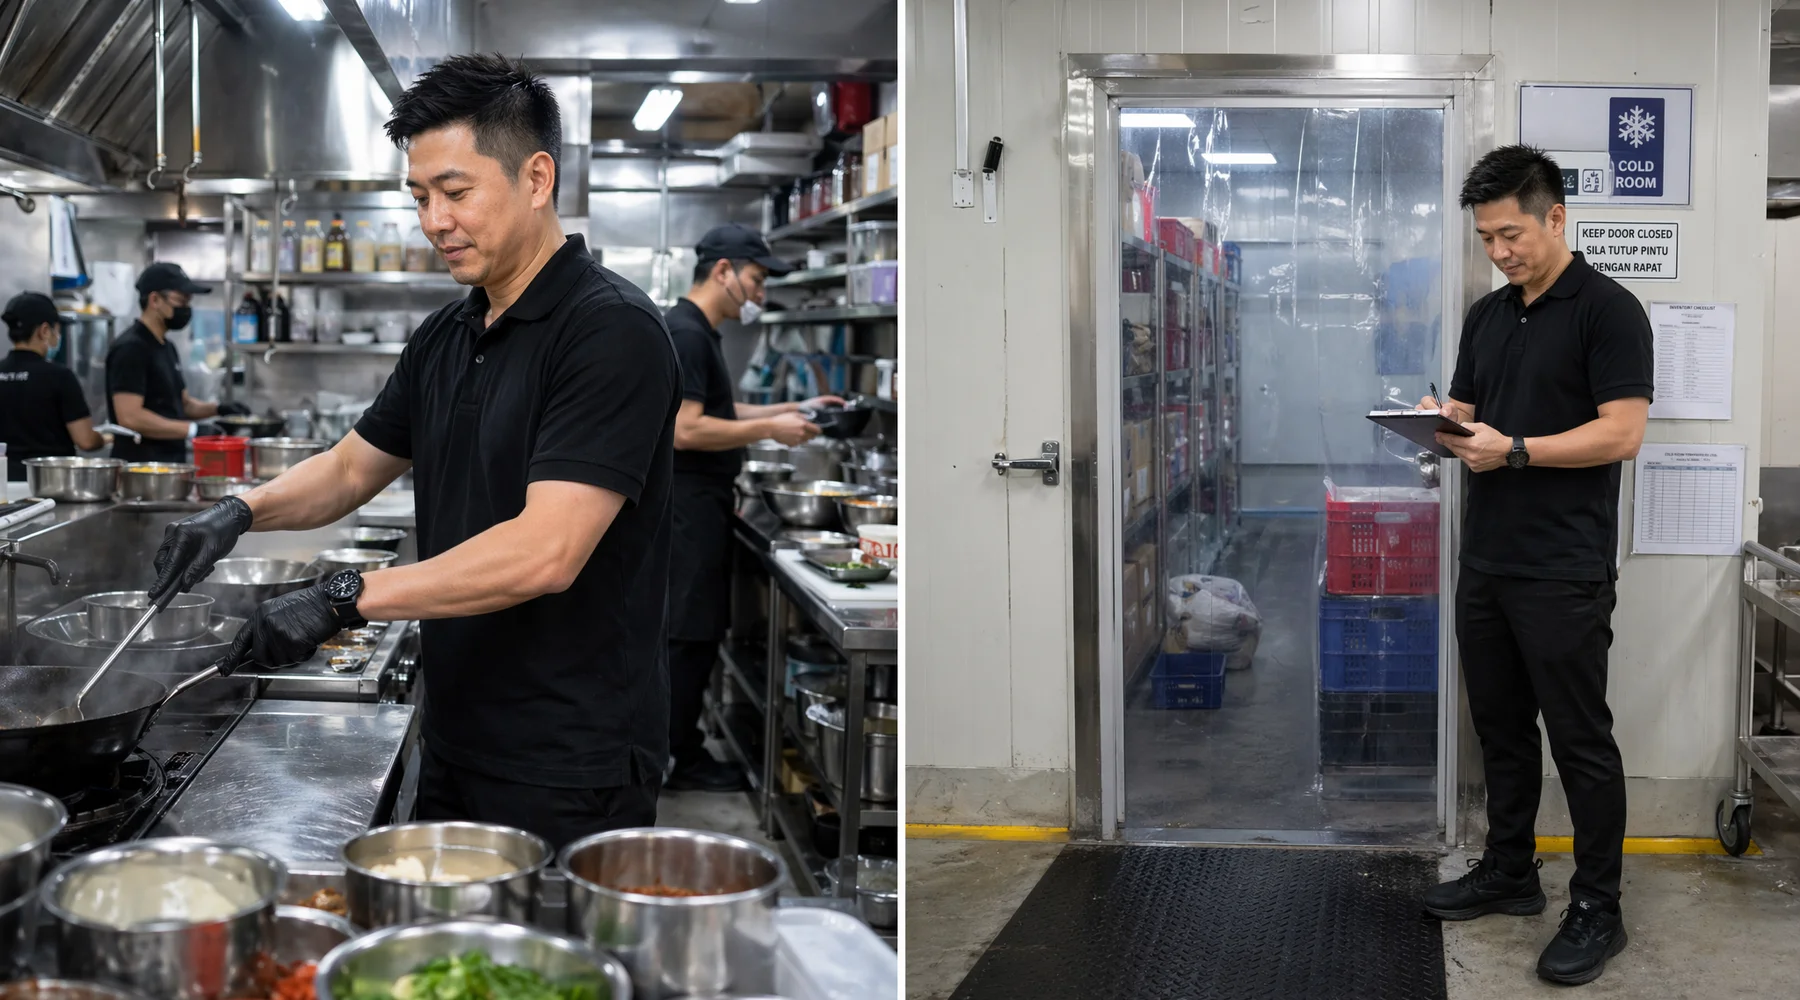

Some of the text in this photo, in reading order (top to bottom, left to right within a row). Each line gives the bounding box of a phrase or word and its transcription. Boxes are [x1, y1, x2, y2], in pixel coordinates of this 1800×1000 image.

[1618, 160, 1654, 172] COLD
[1615, 176, 1656, 188] ROOM
[1582, 228, 1673, 239] KEEP DOOR CLOSED
[1586, 245, 1668, 256] SILA TUTUP PINTU
[1592, 262, 1663, 272] DENGAN RAPAT
